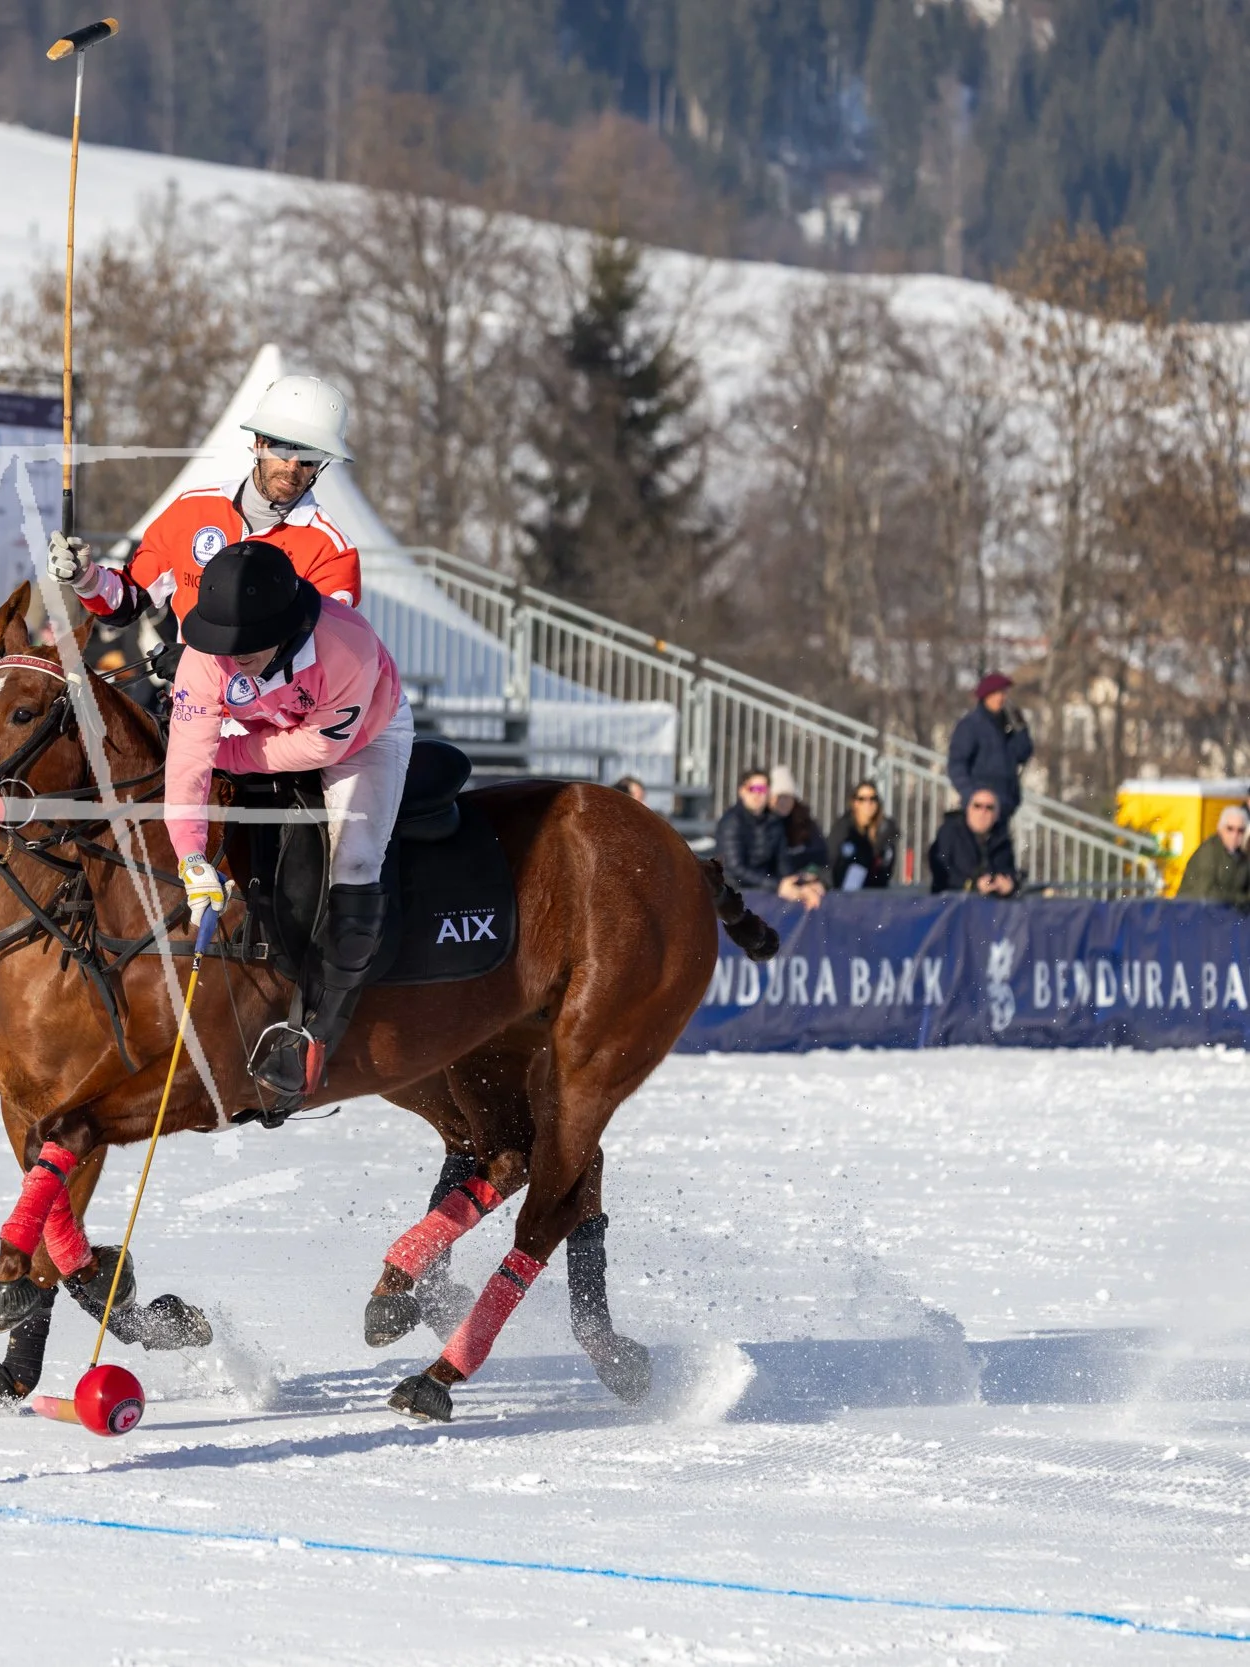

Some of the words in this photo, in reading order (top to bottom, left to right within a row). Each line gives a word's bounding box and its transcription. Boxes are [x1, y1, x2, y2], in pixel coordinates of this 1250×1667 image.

[318, 704, 361, 741] 2
[435, 914, 498, 944] AIX
[851, 957, 944, 1007] BANK
[1033, 959, 1192, 1010] BENDURA
